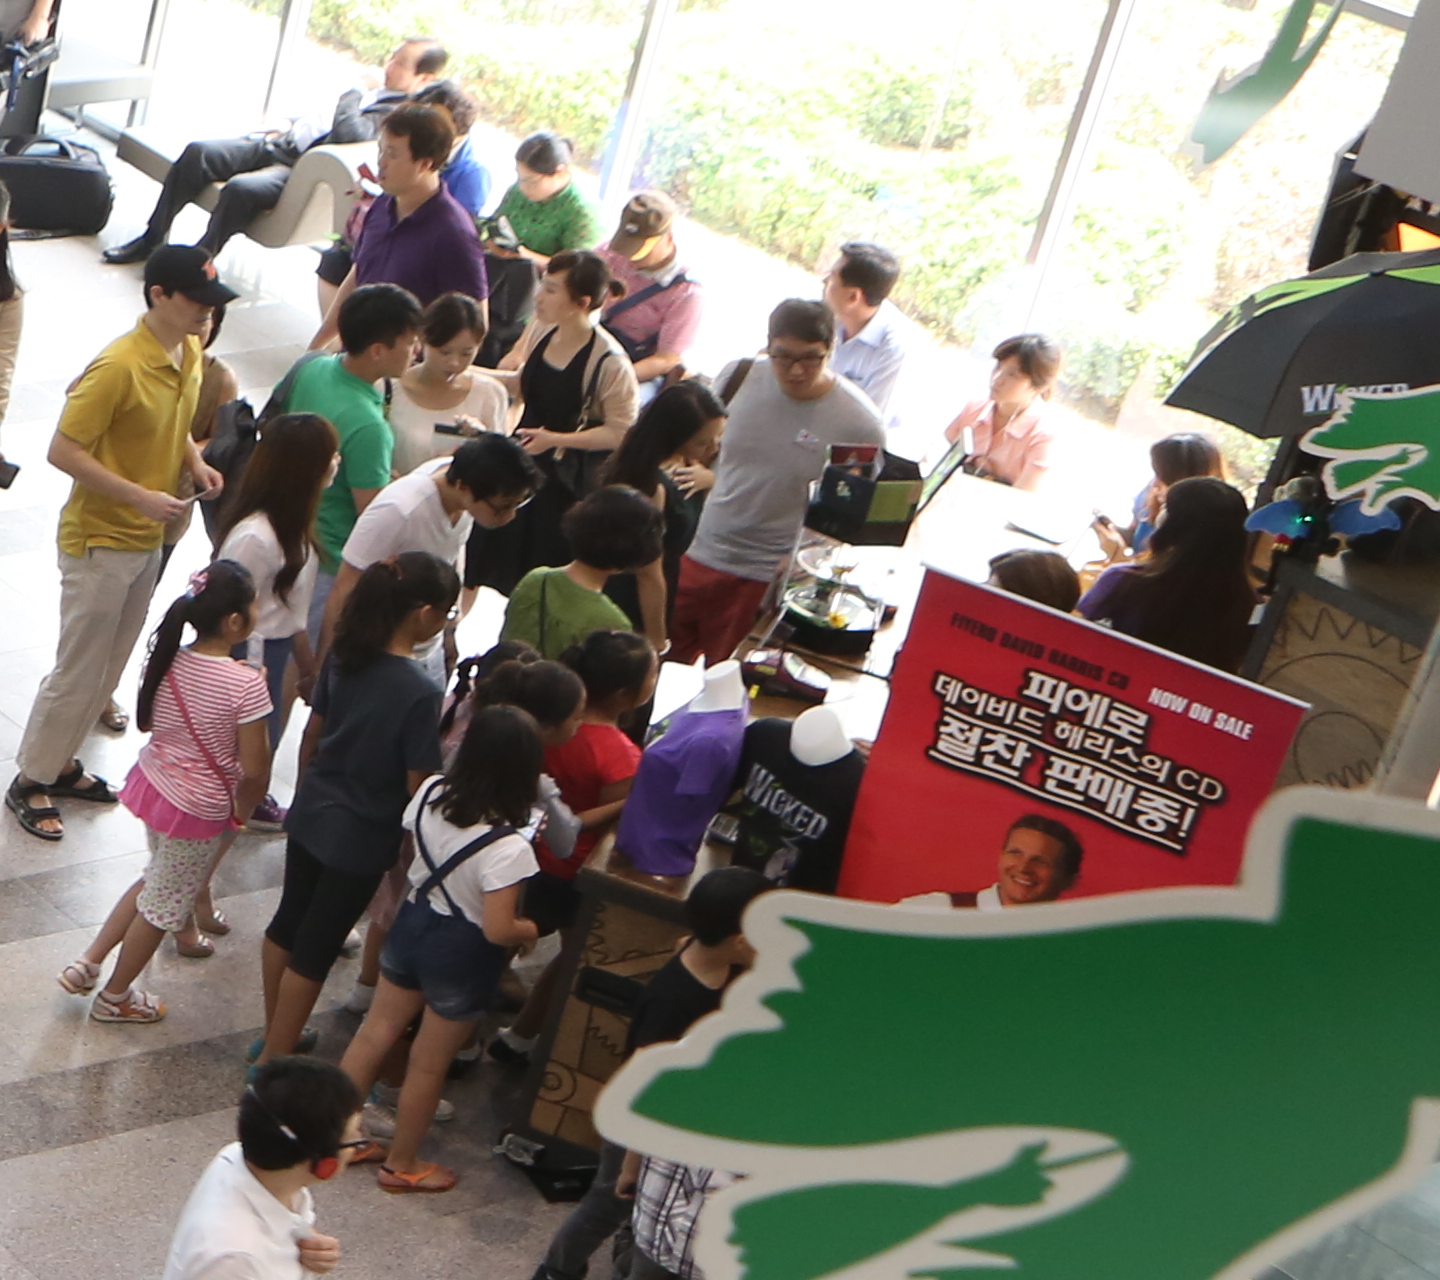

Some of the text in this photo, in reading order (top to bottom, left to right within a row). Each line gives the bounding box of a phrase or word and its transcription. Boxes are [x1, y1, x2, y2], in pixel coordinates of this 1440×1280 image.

[1000, 632, 1045, 659] DAVID
[934, 674, 1224, 801] 데이비드 해리스의 CD
[1022, 671, 1149, 745] 피에로
[1147, 687, 1254, 741] NOW ON SALE
[936, 716, 1197, 838] 절찬 판매중!
